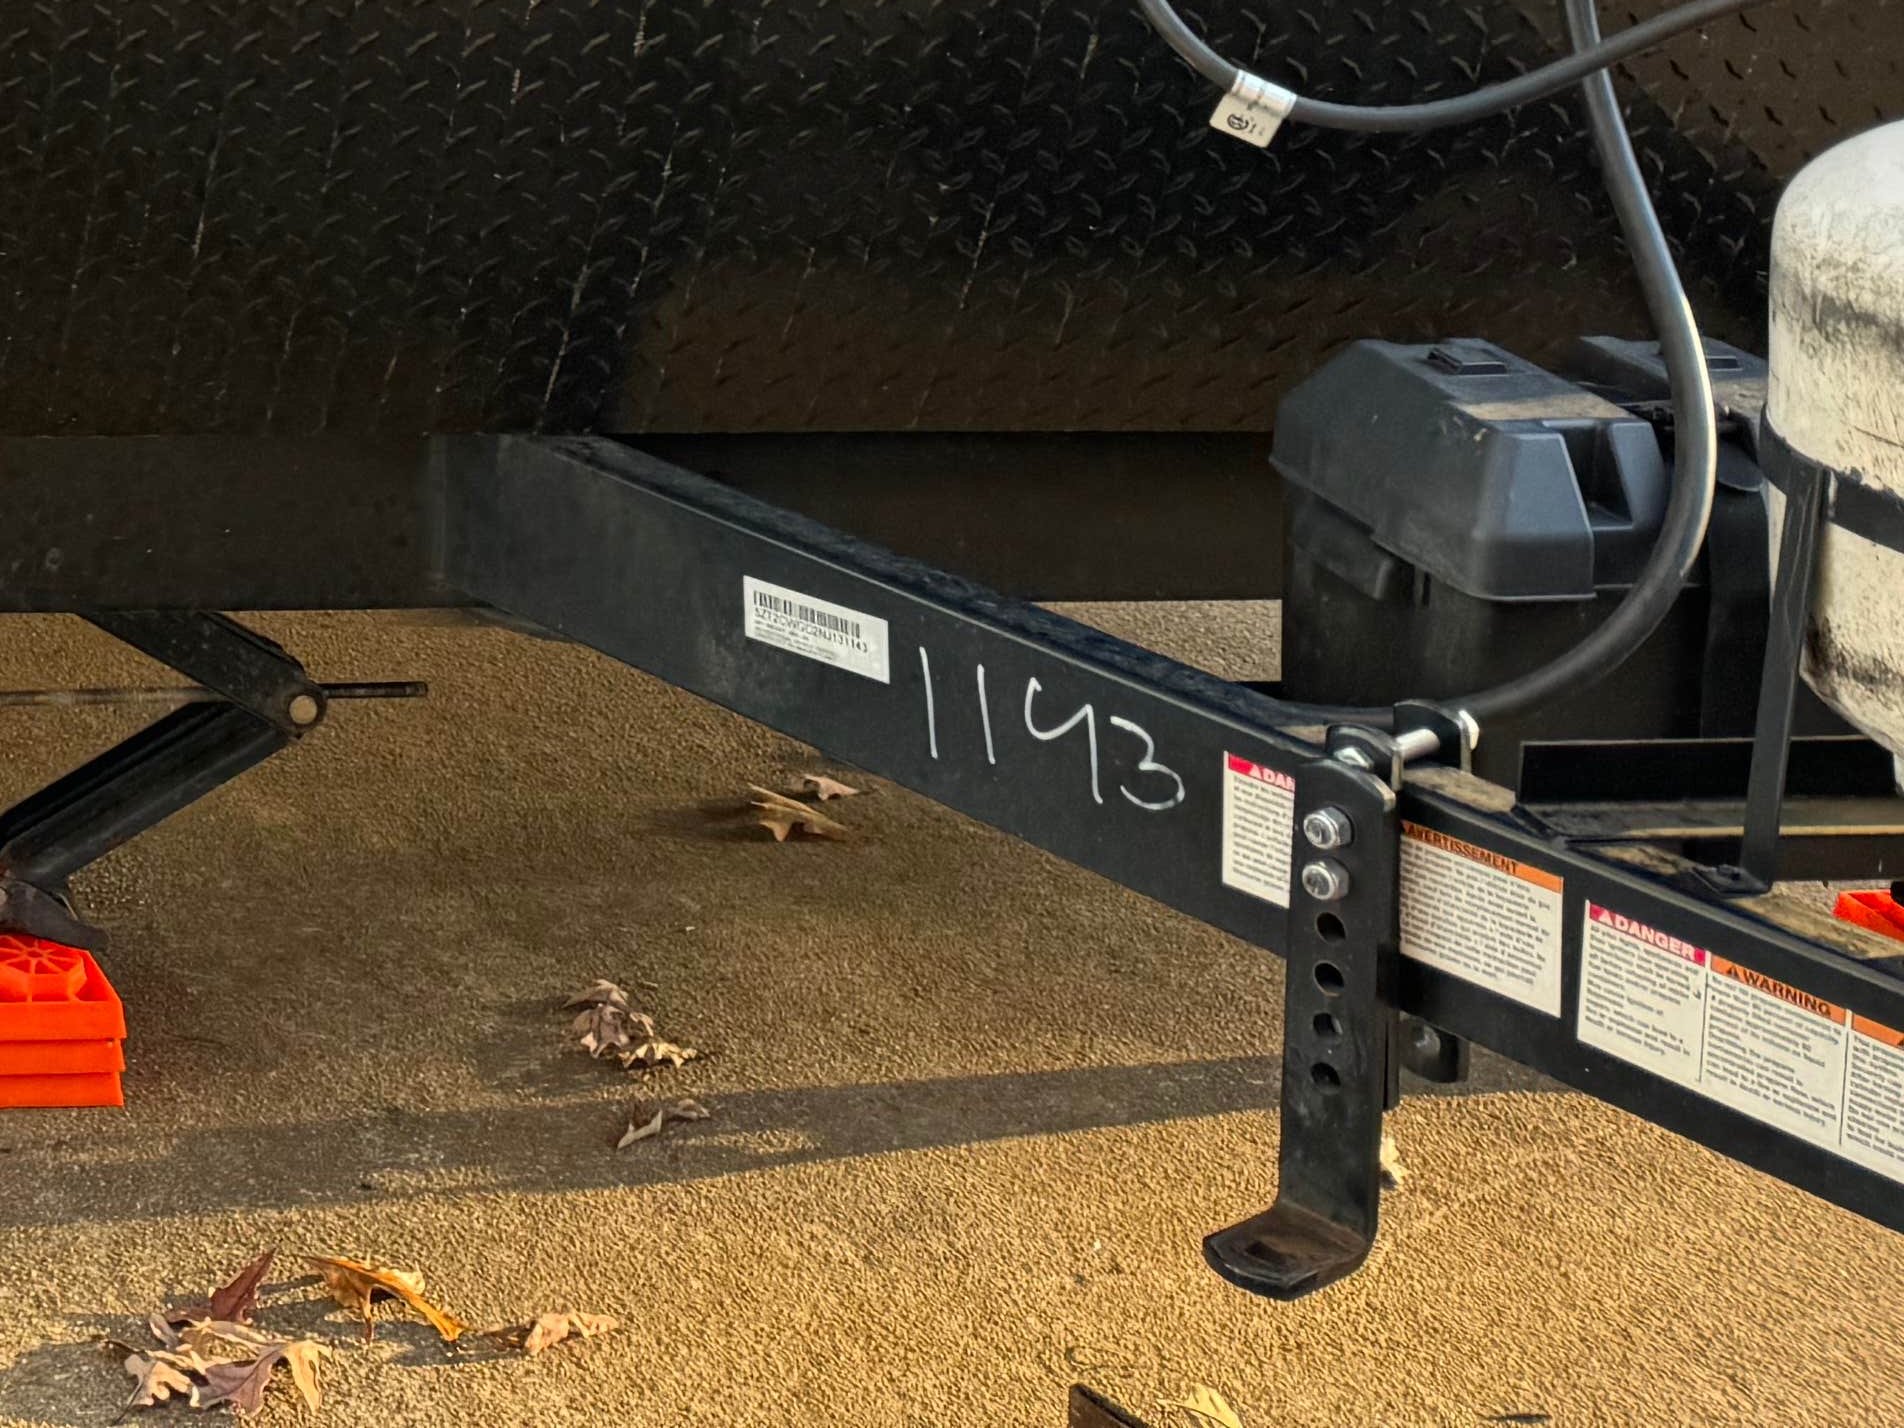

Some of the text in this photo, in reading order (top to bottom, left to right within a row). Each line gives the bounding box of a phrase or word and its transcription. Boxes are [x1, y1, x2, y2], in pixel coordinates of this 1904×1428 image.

[918, 645, 1186, 811] 1143
[1407, 823, 1518, 875] AVERTISSEMENT
[1614, 915, 1695, 959] DANGER
[1743, 969, 1832, 1016] WARNING
